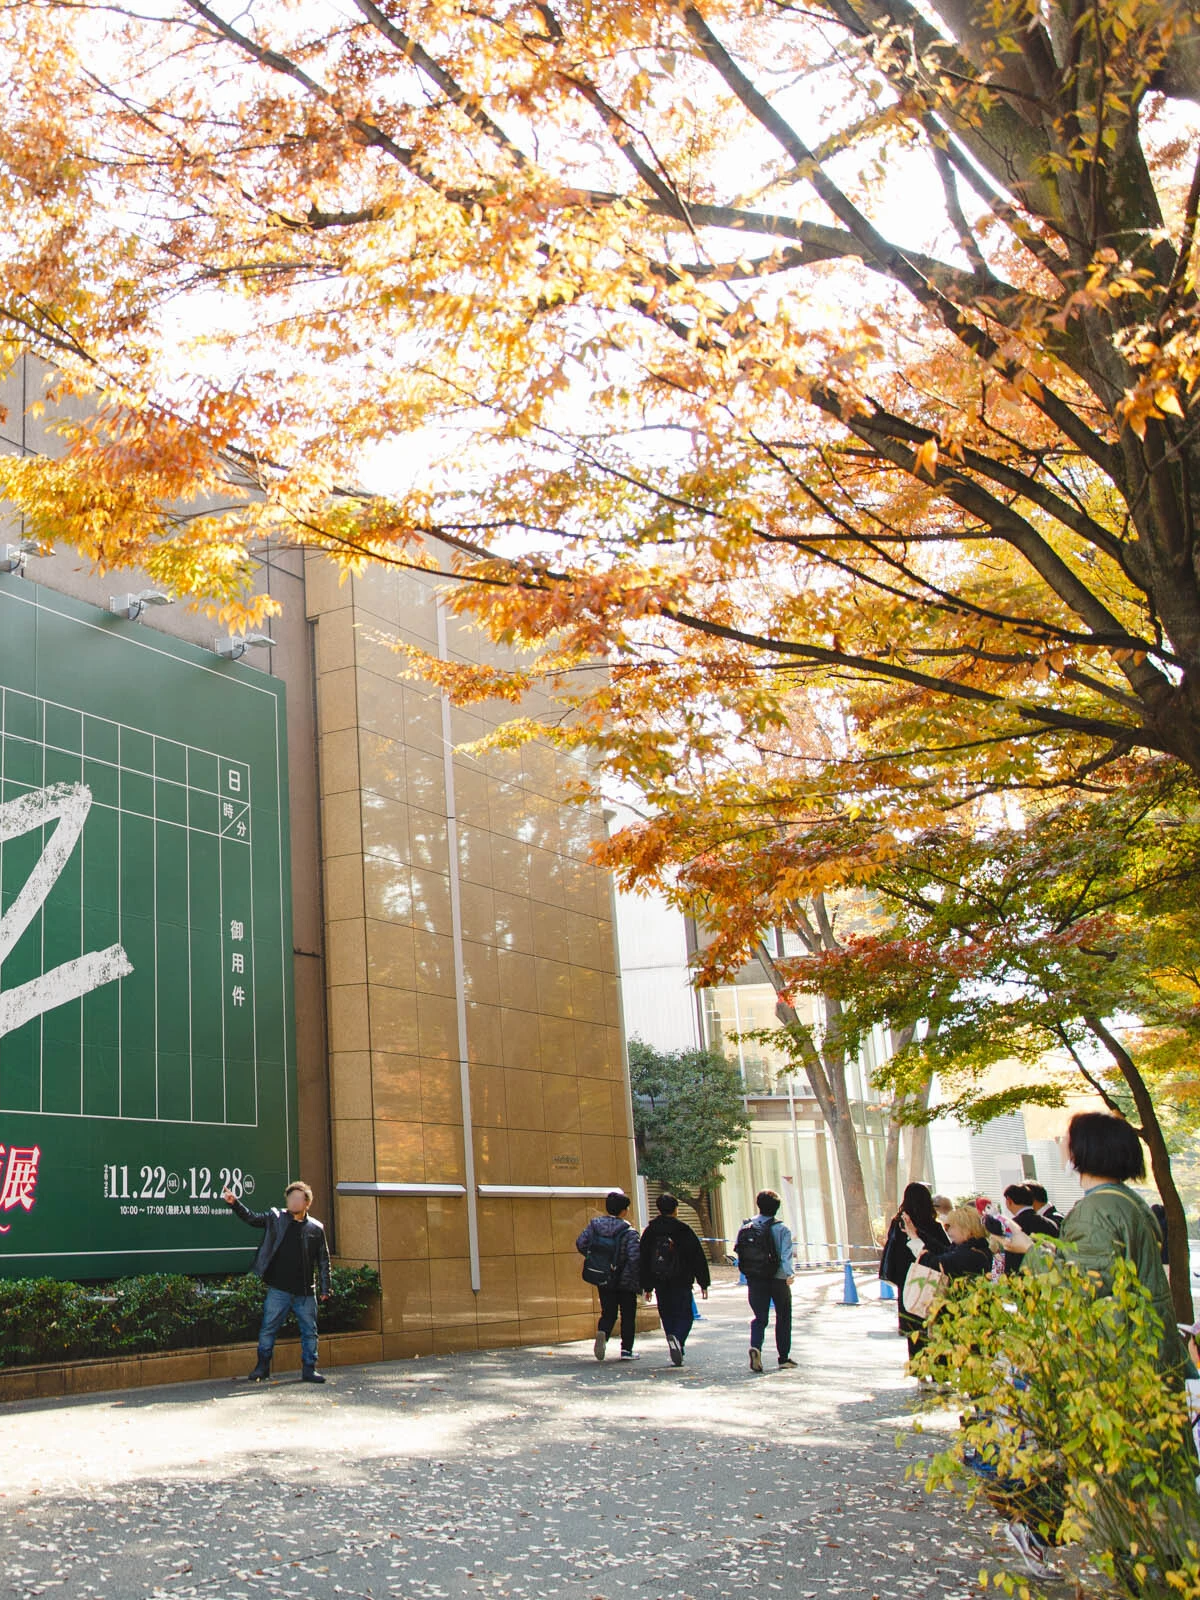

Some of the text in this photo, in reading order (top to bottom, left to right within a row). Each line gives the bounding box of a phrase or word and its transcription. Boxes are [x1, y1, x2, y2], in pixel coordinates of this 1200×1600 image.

[228, 769, 240, 791] 日
[223, 802, 234, 819] 時
[236, 821, 247, 837] 分
[230, 920, 246, 1007] 御用件
[109, 1164, 166, 1199] 11.22
[189, 1167, 243, 1200] 12.28
[120, 1206, 138, 1215] 10:00
[146, 1206, 164, 1215] 17:00
